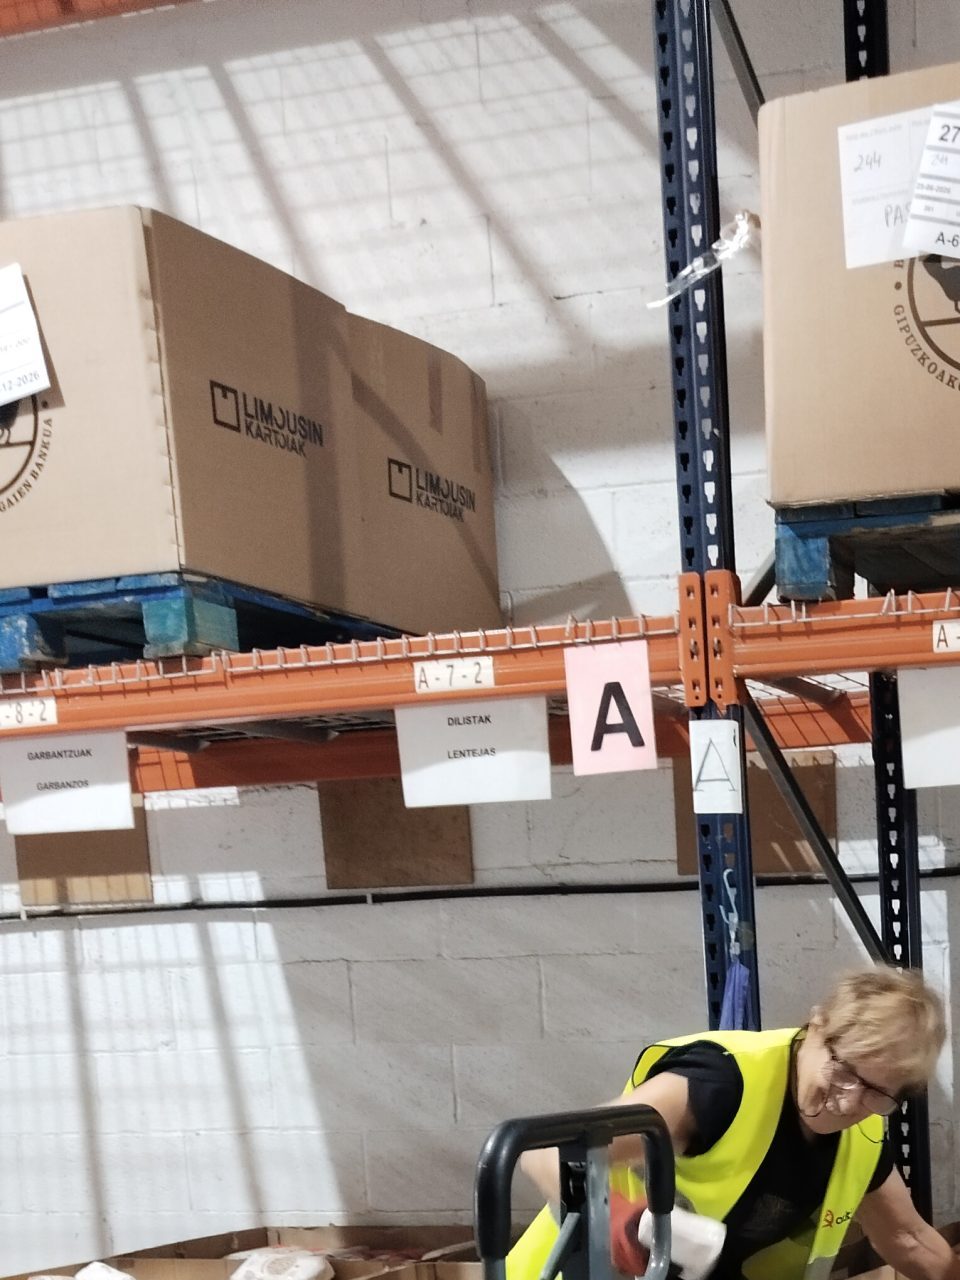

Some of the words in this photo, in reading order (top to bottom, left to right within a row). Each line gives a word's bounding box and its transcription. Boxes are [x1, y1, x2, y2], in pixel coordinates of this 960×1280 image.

[31, 418, 53, 481] BANKUA
[447, 715, 492, 728] DILISTAK
[591, 681, 646, 752] A
[27, 749, 93, 761] GARBANTZUAK
[447, 748, 497, 760] LENTEJAS
[693, 738, 738, 793] A
[36, 780, 89, 791] GARBANZOS
